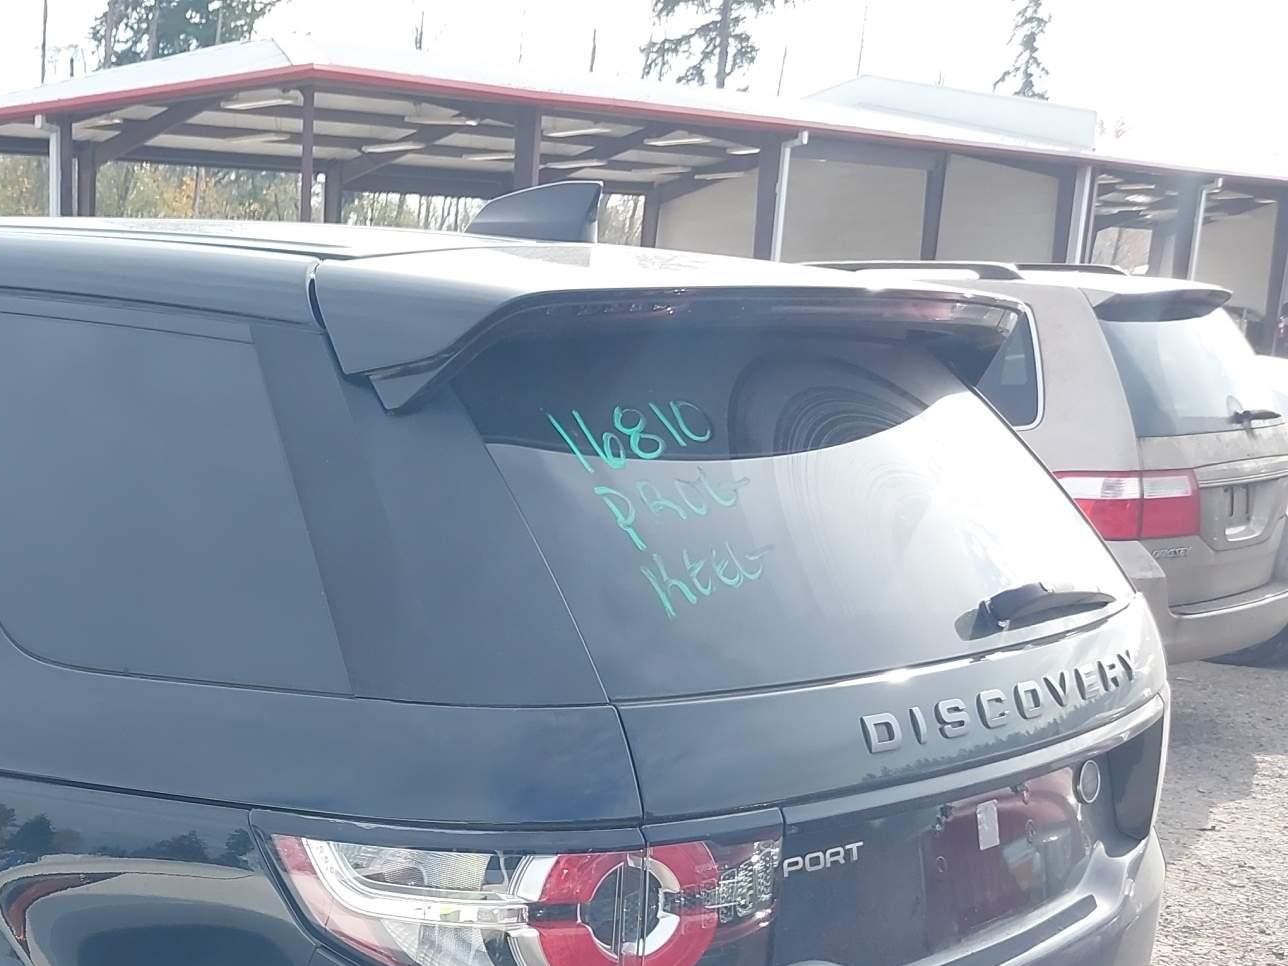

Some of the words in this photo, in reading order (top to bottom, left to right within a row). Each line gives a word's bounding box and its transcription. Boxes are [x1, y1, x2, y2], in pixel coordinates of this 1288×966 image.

[544, 400, 712, 472] 16810
[860, 649, 1137, 753] DISCOVERY
[782, 841, 864, 878] PORT
